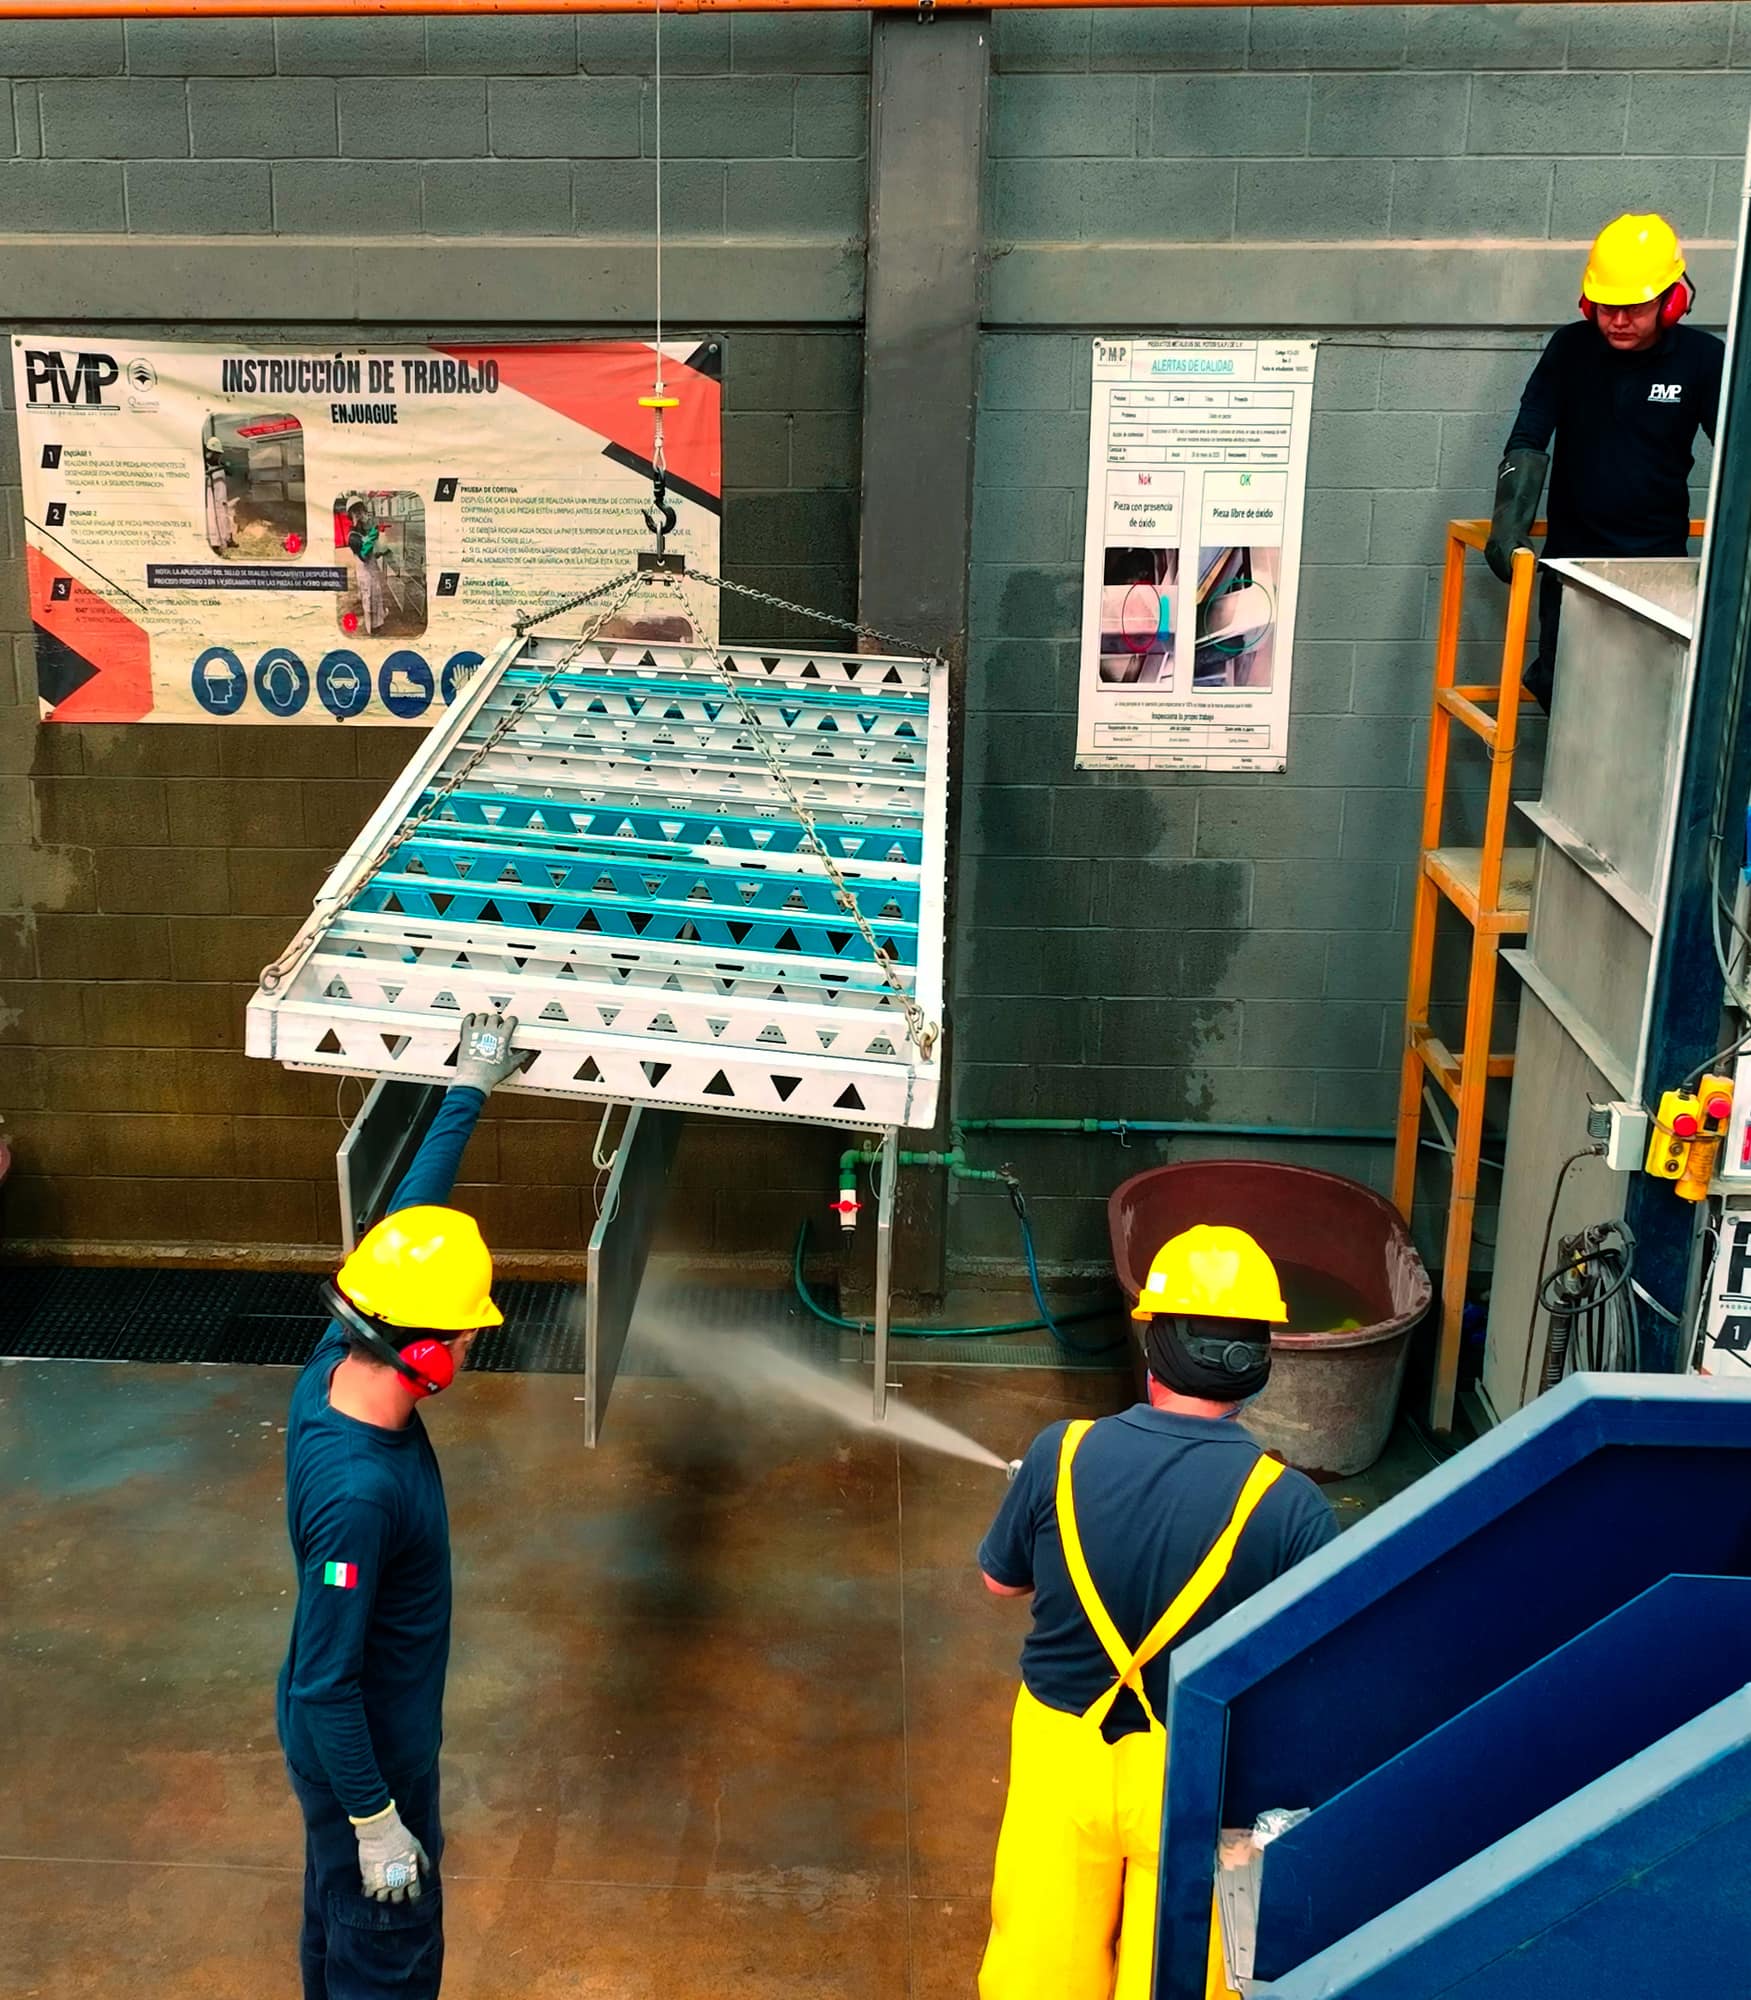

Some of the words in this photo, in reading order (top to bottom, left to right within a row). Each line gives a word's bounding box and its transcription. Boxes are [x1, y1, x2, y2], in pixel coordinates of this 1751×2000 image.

[1152, 359, 1186, 371] ALERTAS
[1188, 360, 1199, 371] DE
[1201, 360, 1234, 371] CALIDAD
[25, 350, 119, 404] PMP
[222, 352, 360, 393] INSTRUCCIÓN
[368, 359, 395, 393] DE
[401, 359, 499, 393] TRABAJO
[1650, 384, 1682, 399] PMP
[331, 404, 398, 424] ENJUAGUE
[48, 451, 54, 462] 1
[1138, 473, 1151, 485] Nok
[1240, 474, 1252, 486] OK
[443, 484, 450, 495] 4
[1113, 501, 1130, 511] Pieza
[1143, 503, 1173, 512] presencia
[53, 509, 60, 520] 2
[1213, 508, 1229, 518] Pieza
[1231, 508, 1245, 518] libre
[1246, 508, 1254, 518] de
[1129, 517, 1137, 527] de
[58, 584, 65, 594] 3
[445, 578, 452, 590] 5
[1733, 1325, 1740, 1341] 1
